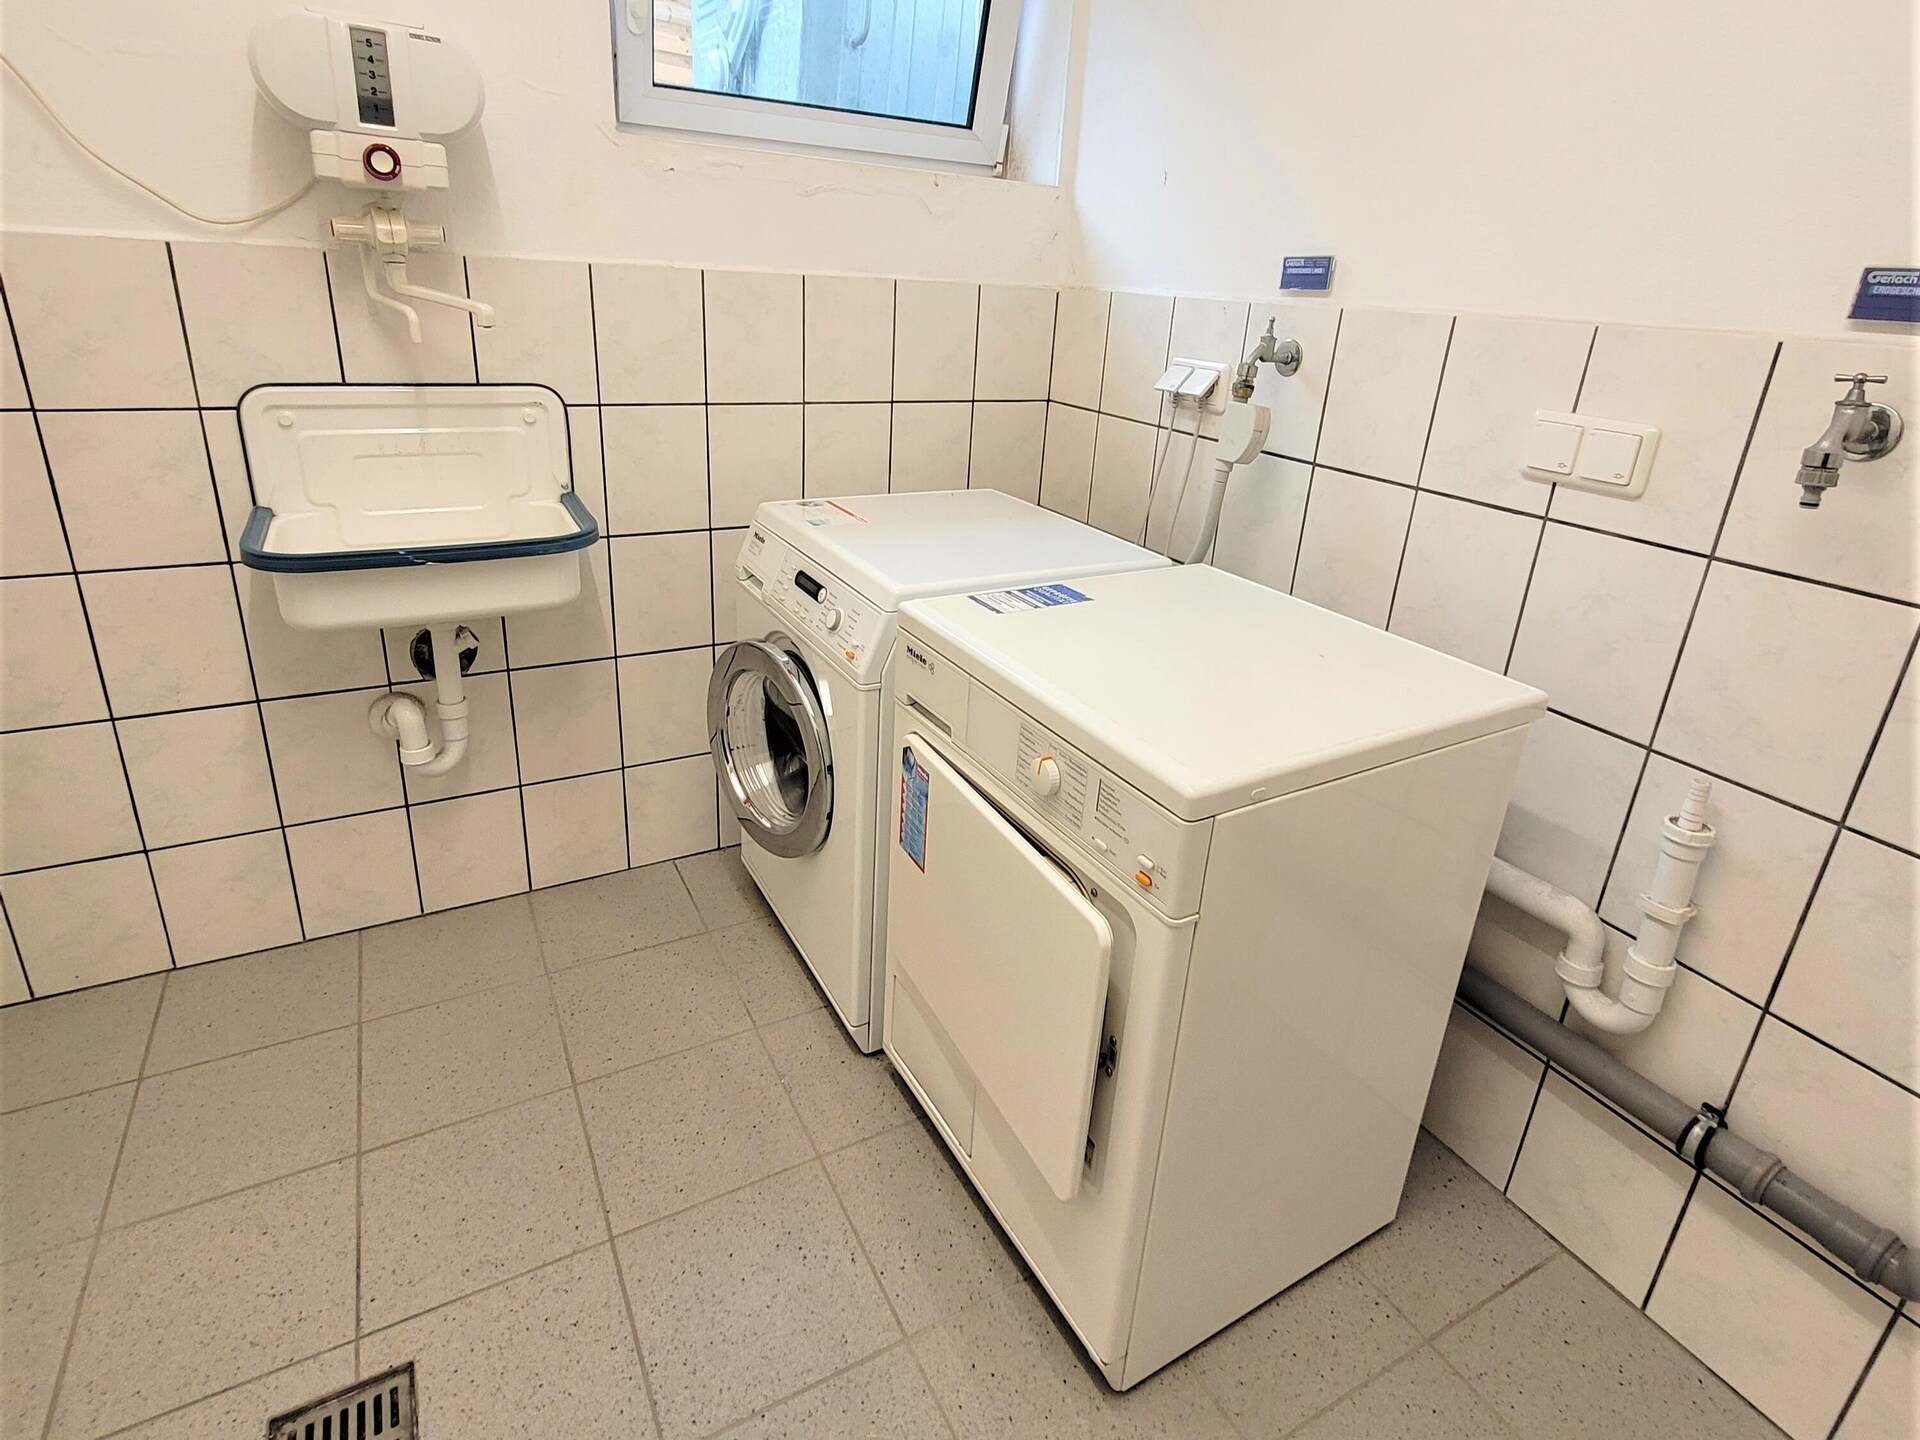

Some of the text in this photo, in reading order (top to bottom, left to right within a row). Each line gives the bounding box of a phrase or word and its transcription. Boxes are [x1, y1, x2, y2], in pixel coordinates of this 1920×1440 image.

[365, 38, 373, 48] 5
[367, 55, 375, 64] 4
[368, 70, 376, 79] 3
[370, 86, 378, 96] 2
[373, 104, 379, 112] 1
[1867, 271, 1920, 284] Gerlach
[906, 645, 927, 666] Miele
